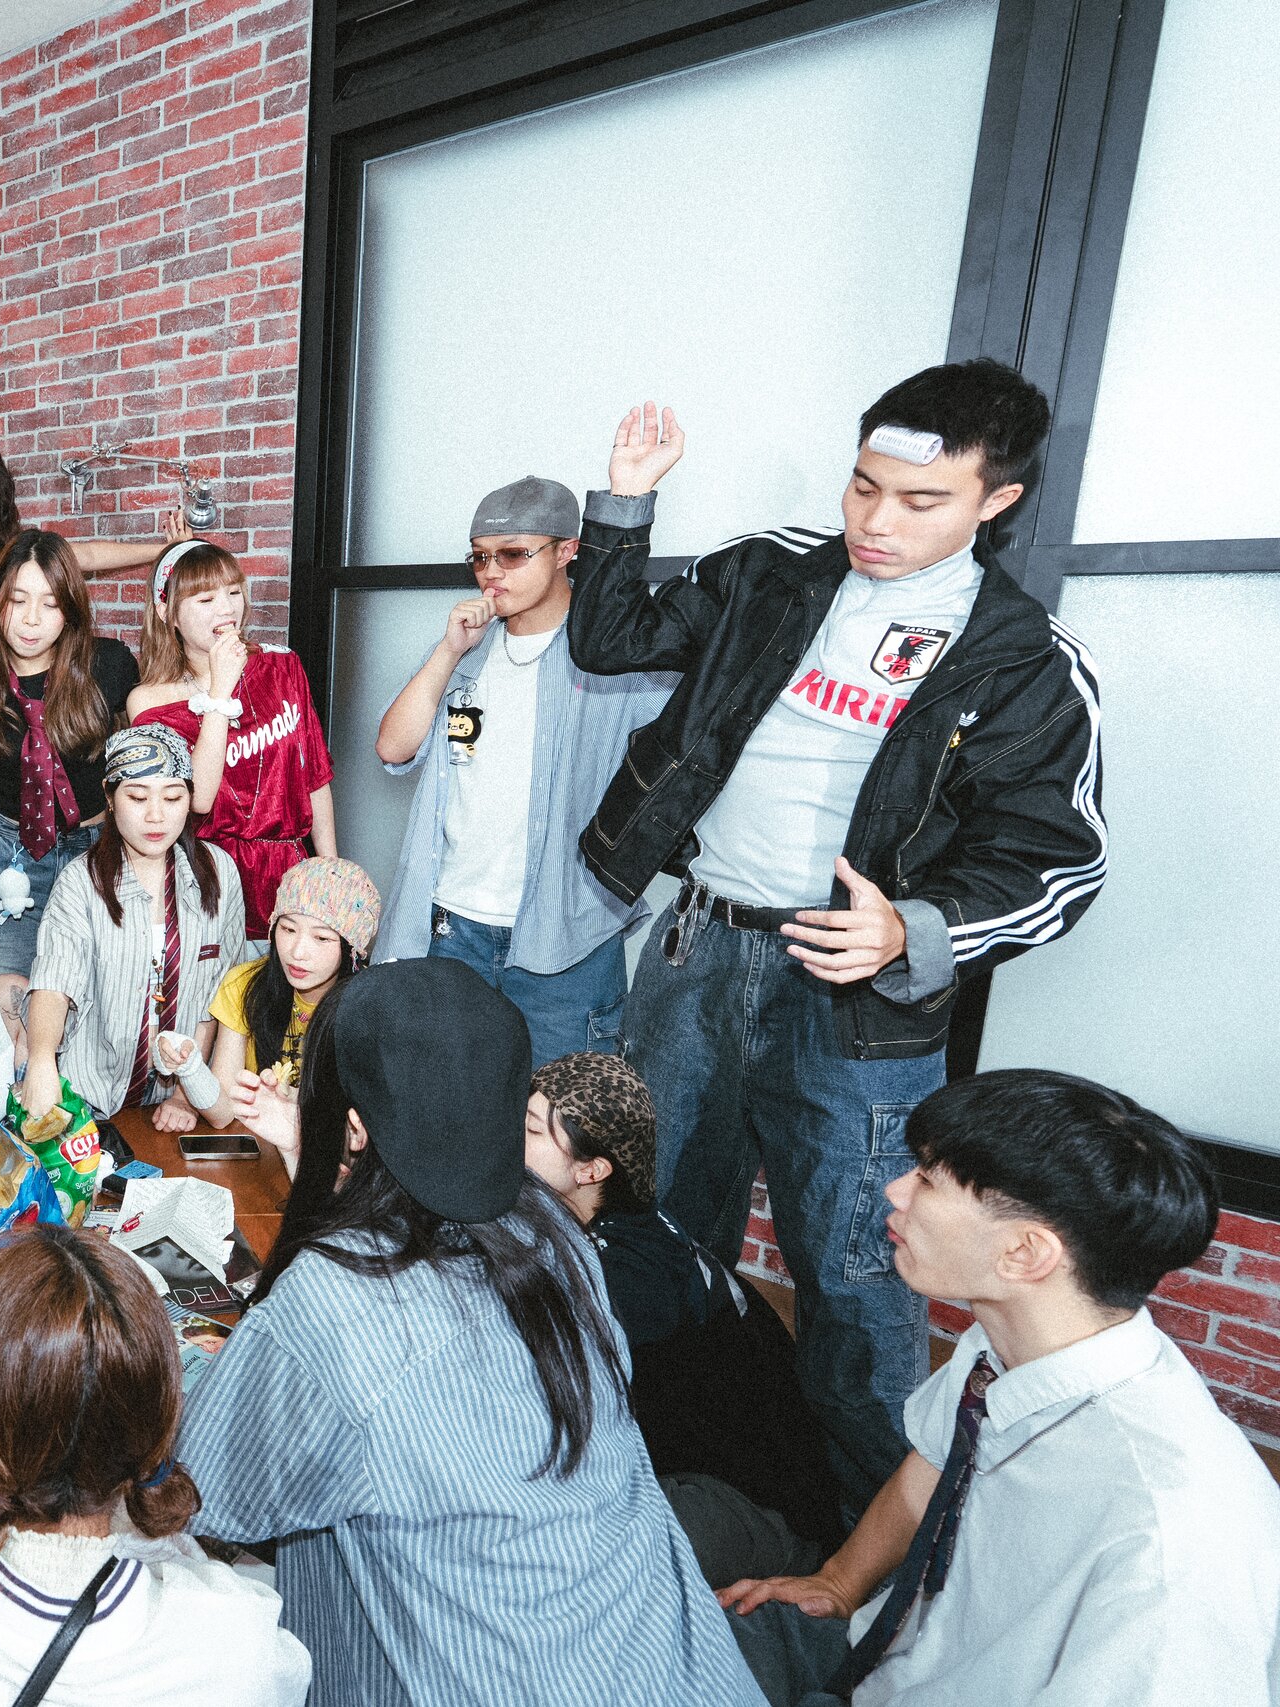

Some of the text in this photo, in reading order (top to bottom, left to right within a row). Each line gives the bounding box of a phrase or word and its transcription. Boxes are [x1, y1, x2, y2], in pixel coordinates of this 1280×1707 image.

[902, 626, 938, 636] JAPAN
[883, 664, 910, 675] JFA
[65, 1132, 99, 1162] Lay
